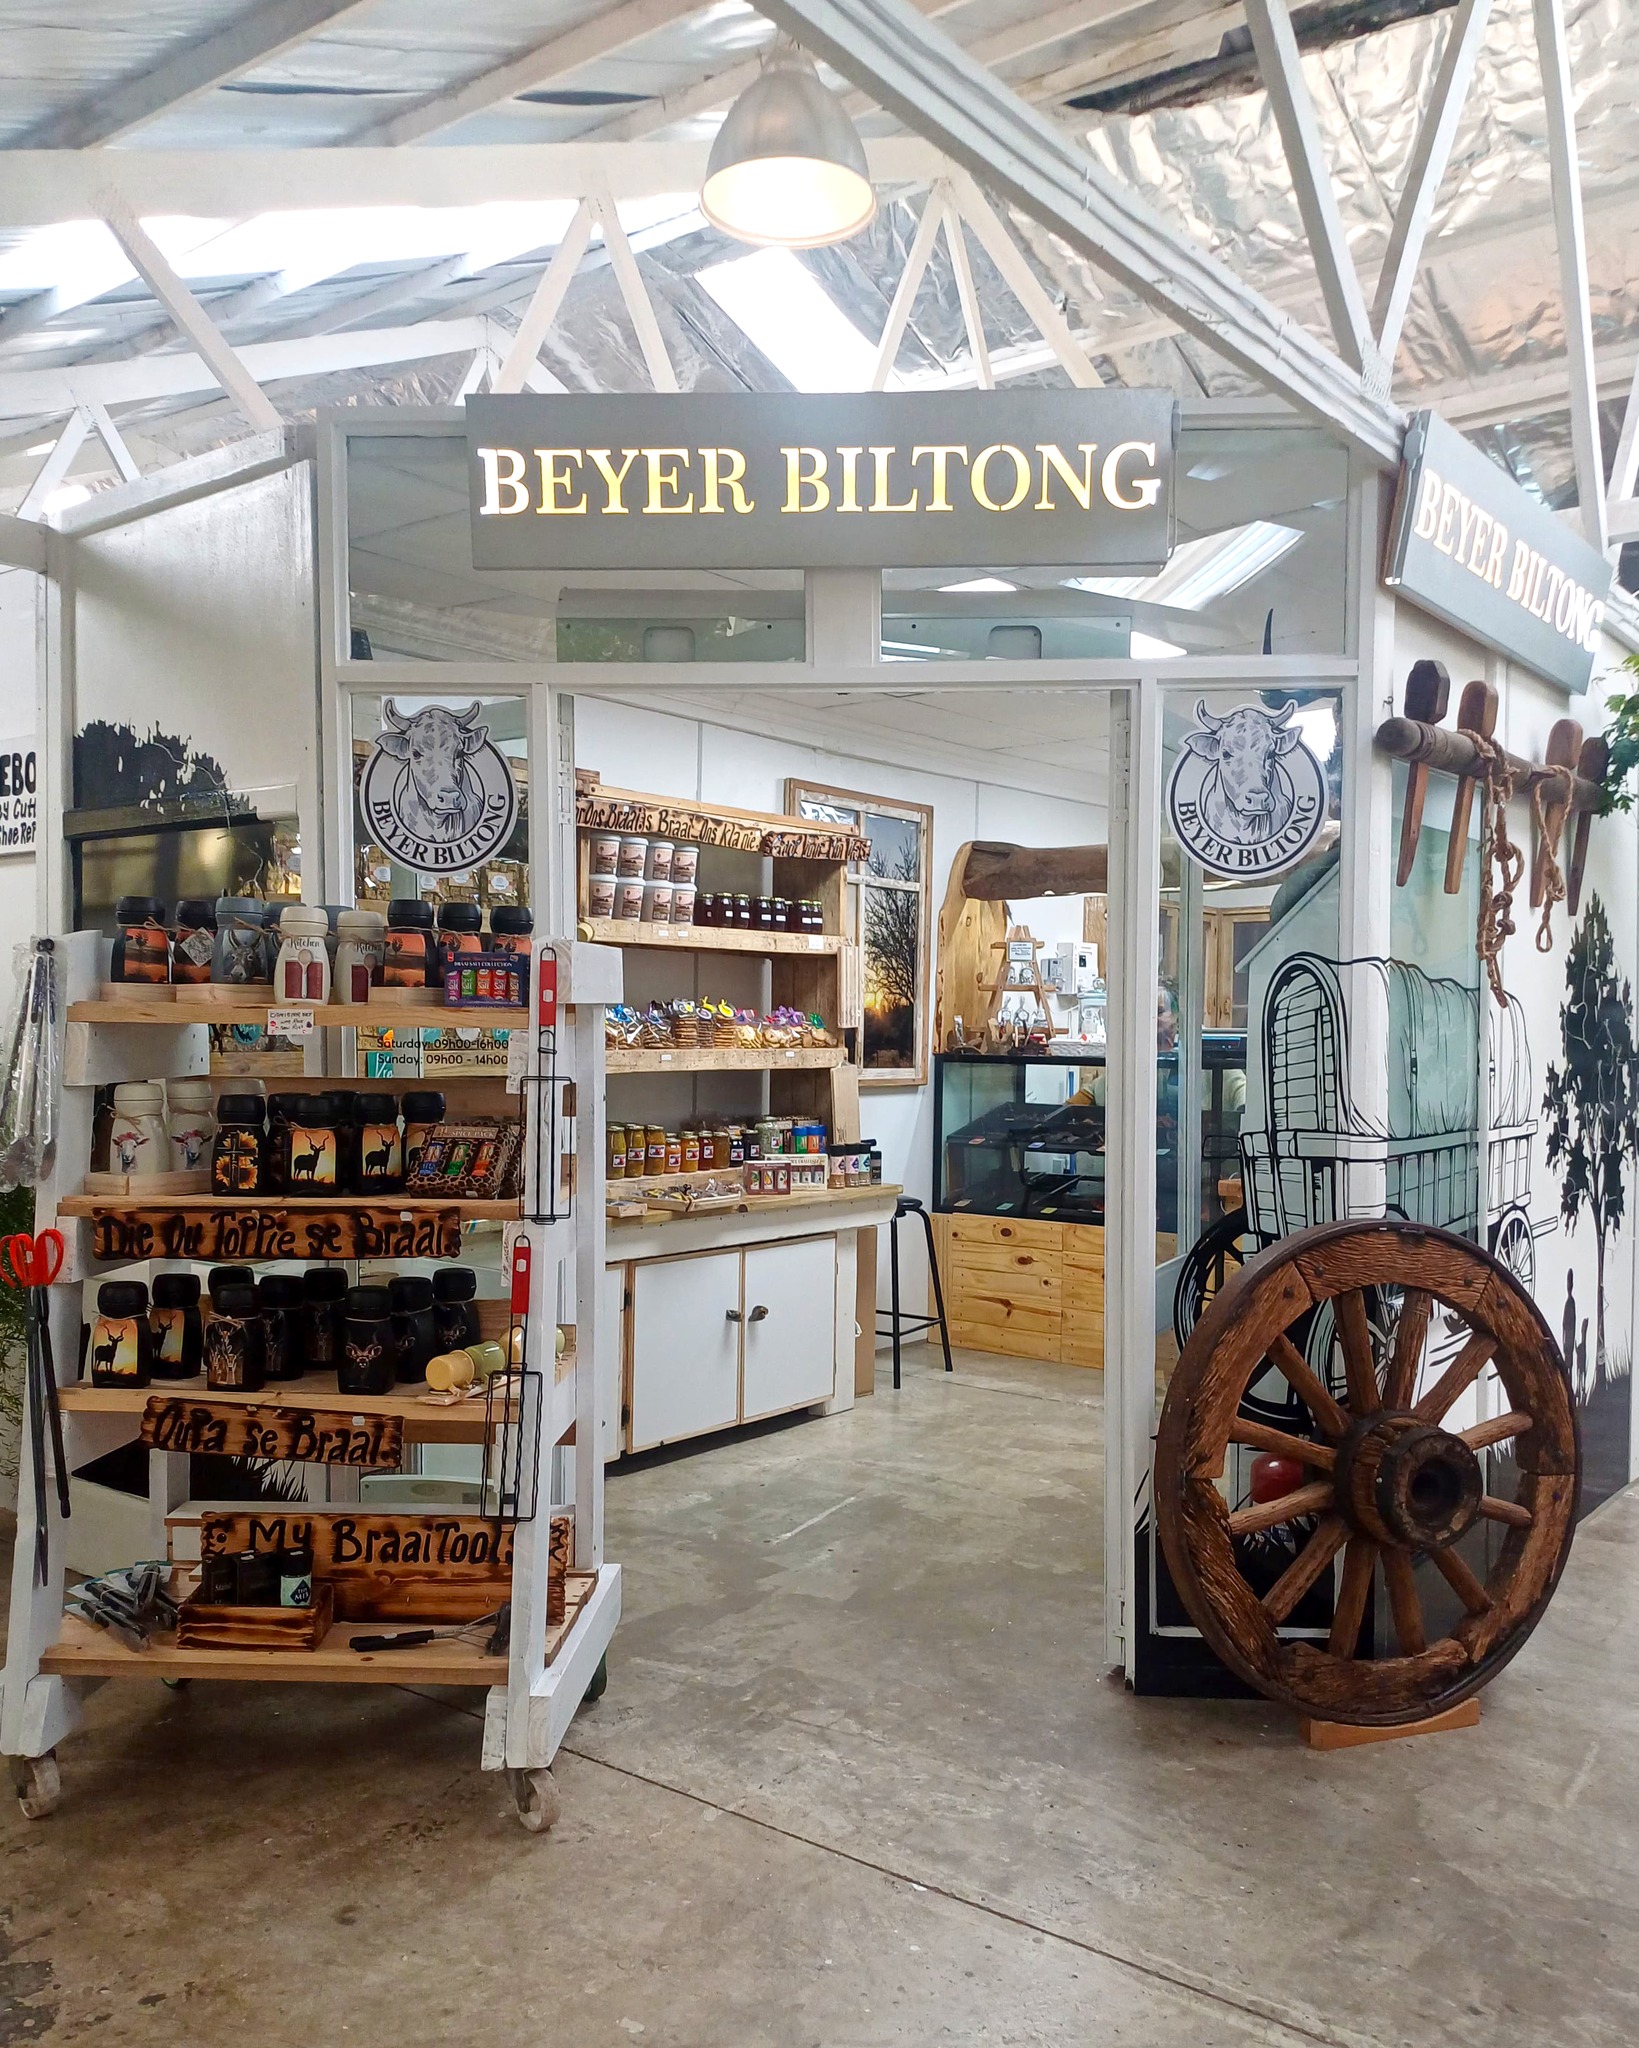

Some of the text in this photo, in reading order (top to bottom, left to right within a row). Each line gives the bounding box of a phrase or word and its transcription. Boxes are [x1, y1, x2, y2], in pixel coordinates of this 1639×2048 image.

[477, 441, 1162, 516] BEYER BILTONG
[1414, 468, 1605, 653] BEYER BILTONG
[373, 793, 506, 865] BEYER BILTONG
[1178, 795, 1316, 867] BEYER BILTONG
[290, 937, 320, 950] Kitchen
[377, 1038, 431, 1050] Saturday:
[377, 1054, 423, 1066] Sunday:
[426, 1054, 463, 1064] 09h00
[474, 1054, 509, 1064] 14h00
[102, 1216, 154, 1257] Die
[163, 1214, 204, 1253] Ou
[306, 1222, 343, 1252] se
[245, 1419, 278, 1454] se
[249, 1519, 312, 1553] My
